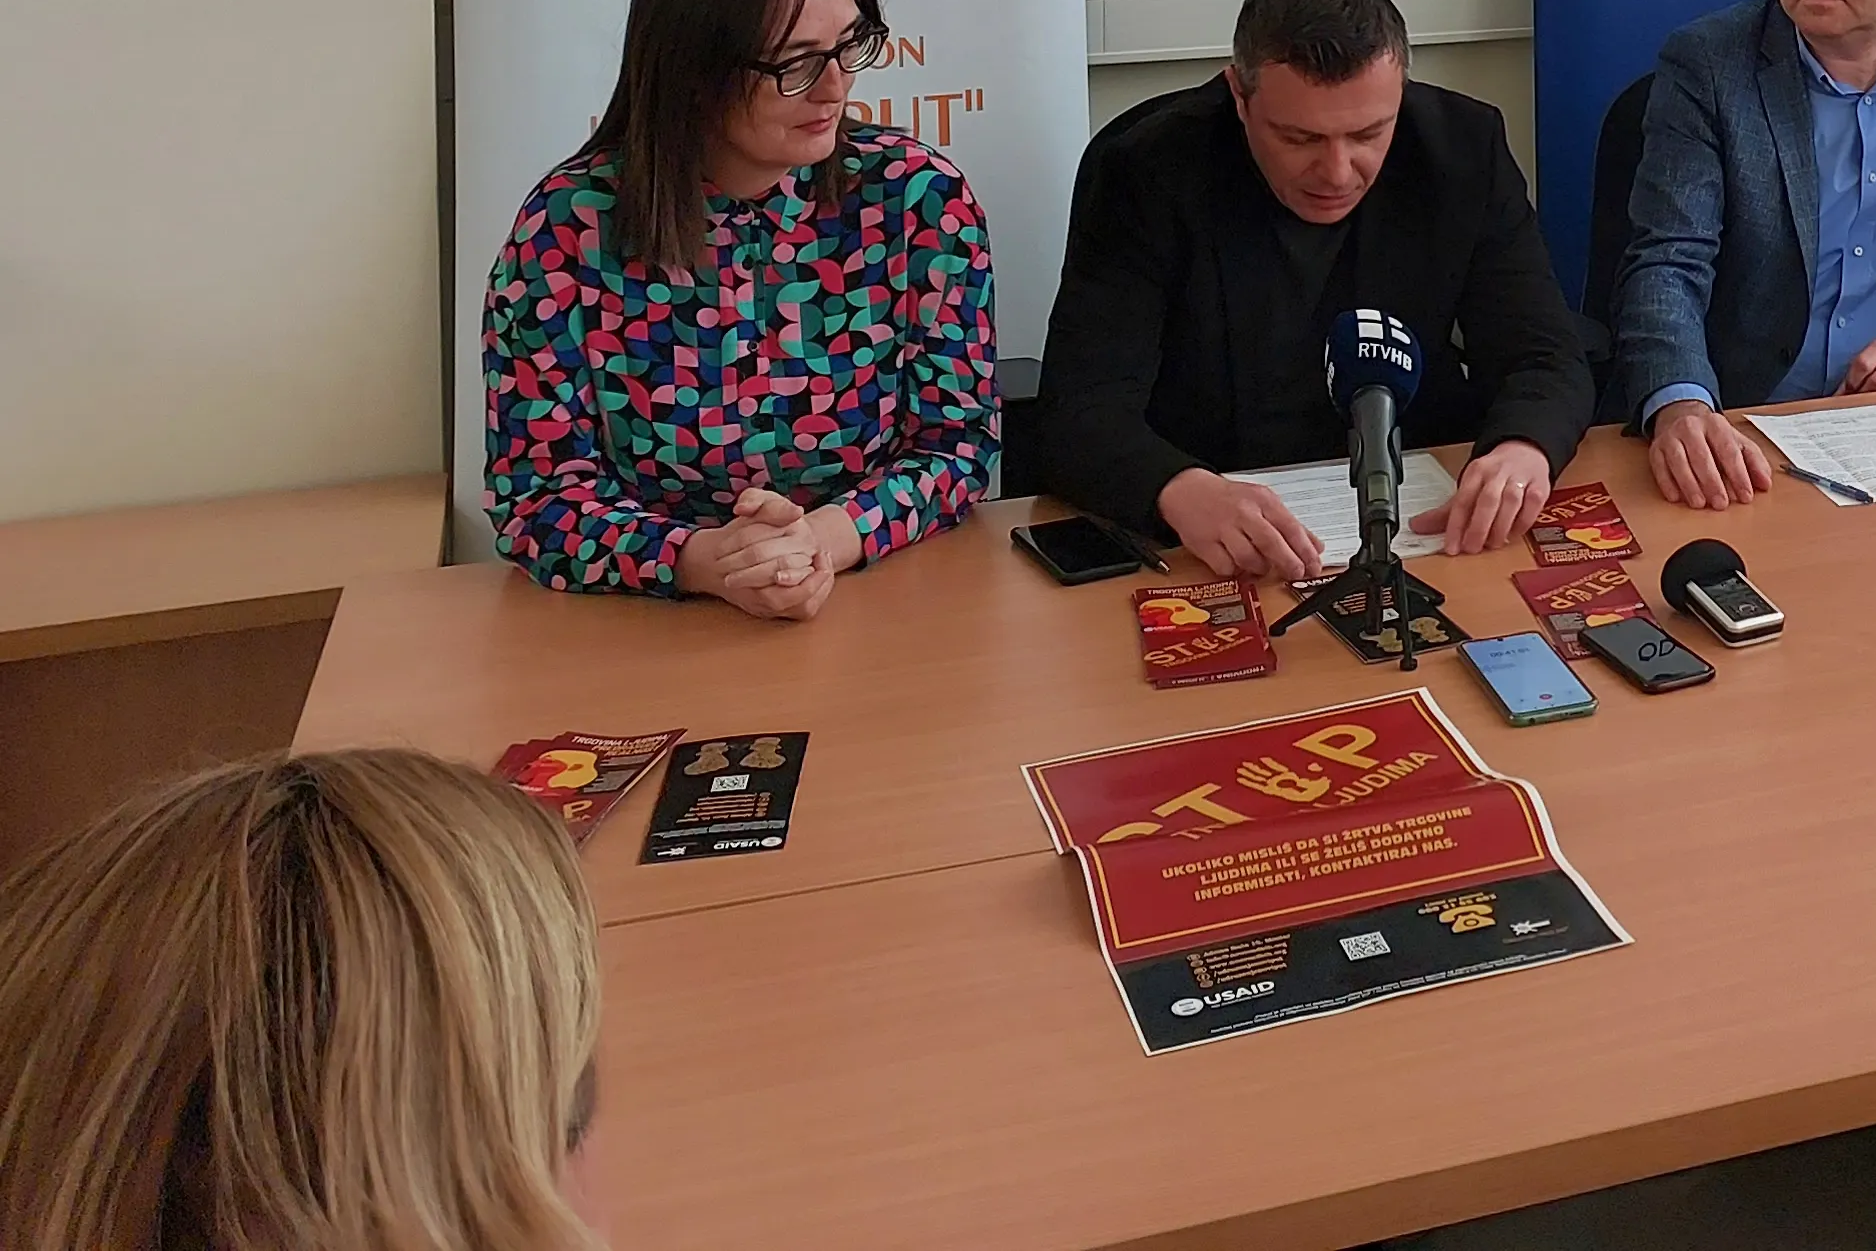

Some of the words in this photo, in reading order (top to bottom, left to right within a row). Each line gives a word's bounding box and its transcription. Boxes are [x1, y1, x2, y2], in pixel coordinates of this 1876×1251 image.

[1358, 343, 1413, 372] RTVHB
[1162, 855, 1235, 880] UKOLIKO
[1296, 838, 1320, 852] DA
[1323, 832, 1339, 846] SI
[1395, 806, 1472, 831] TRGOVINE
[1194, 870, 1306, 902] INFORMISATI,
[1309, 848, 1419, 879] KONTAKTIRAJ
[1421, 840, 1459, 855] NAS.
[1199, 861, 1272, 886] LJUDIMA
[1275, 855, 1297, 870] ILI
[1301, 850, 1320, 864] SE
[1371, 825, 1445, 851] DODATNO
[1203, 981, 1275, 1006] USAID
